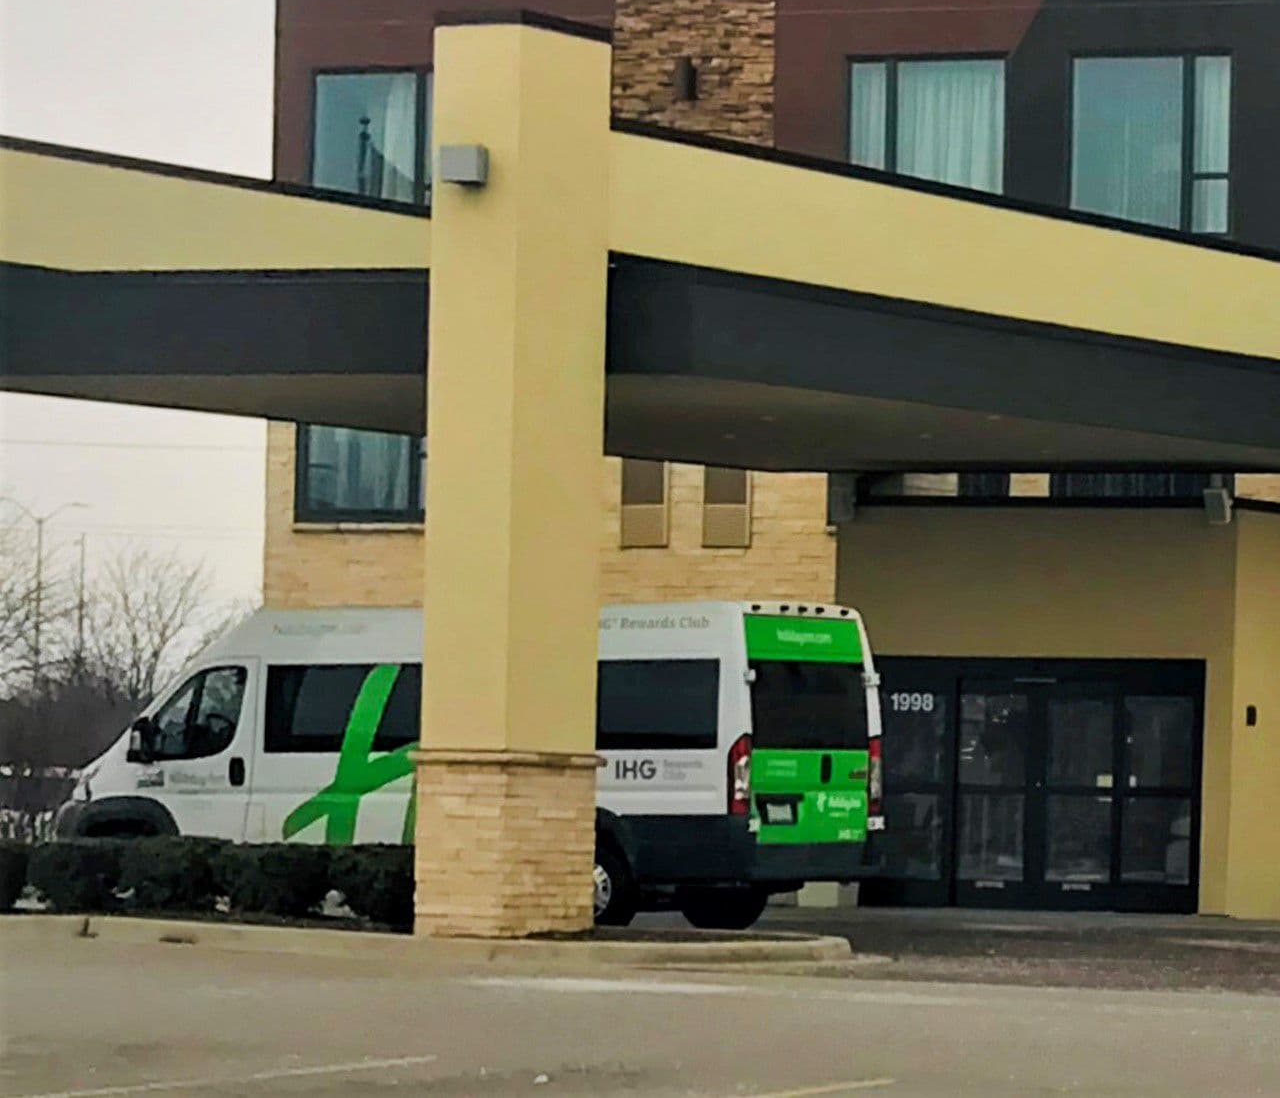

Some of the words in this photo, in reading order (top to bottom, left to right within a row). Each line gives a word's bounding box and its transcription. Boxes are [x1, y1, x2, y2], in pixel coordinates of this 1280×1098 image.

[620, 616, 676, 630] Rewards
[679, 615, 710, 630] Club
[890, 692, 934, 712] 1998
[615, 759, 657, 780] IHG
